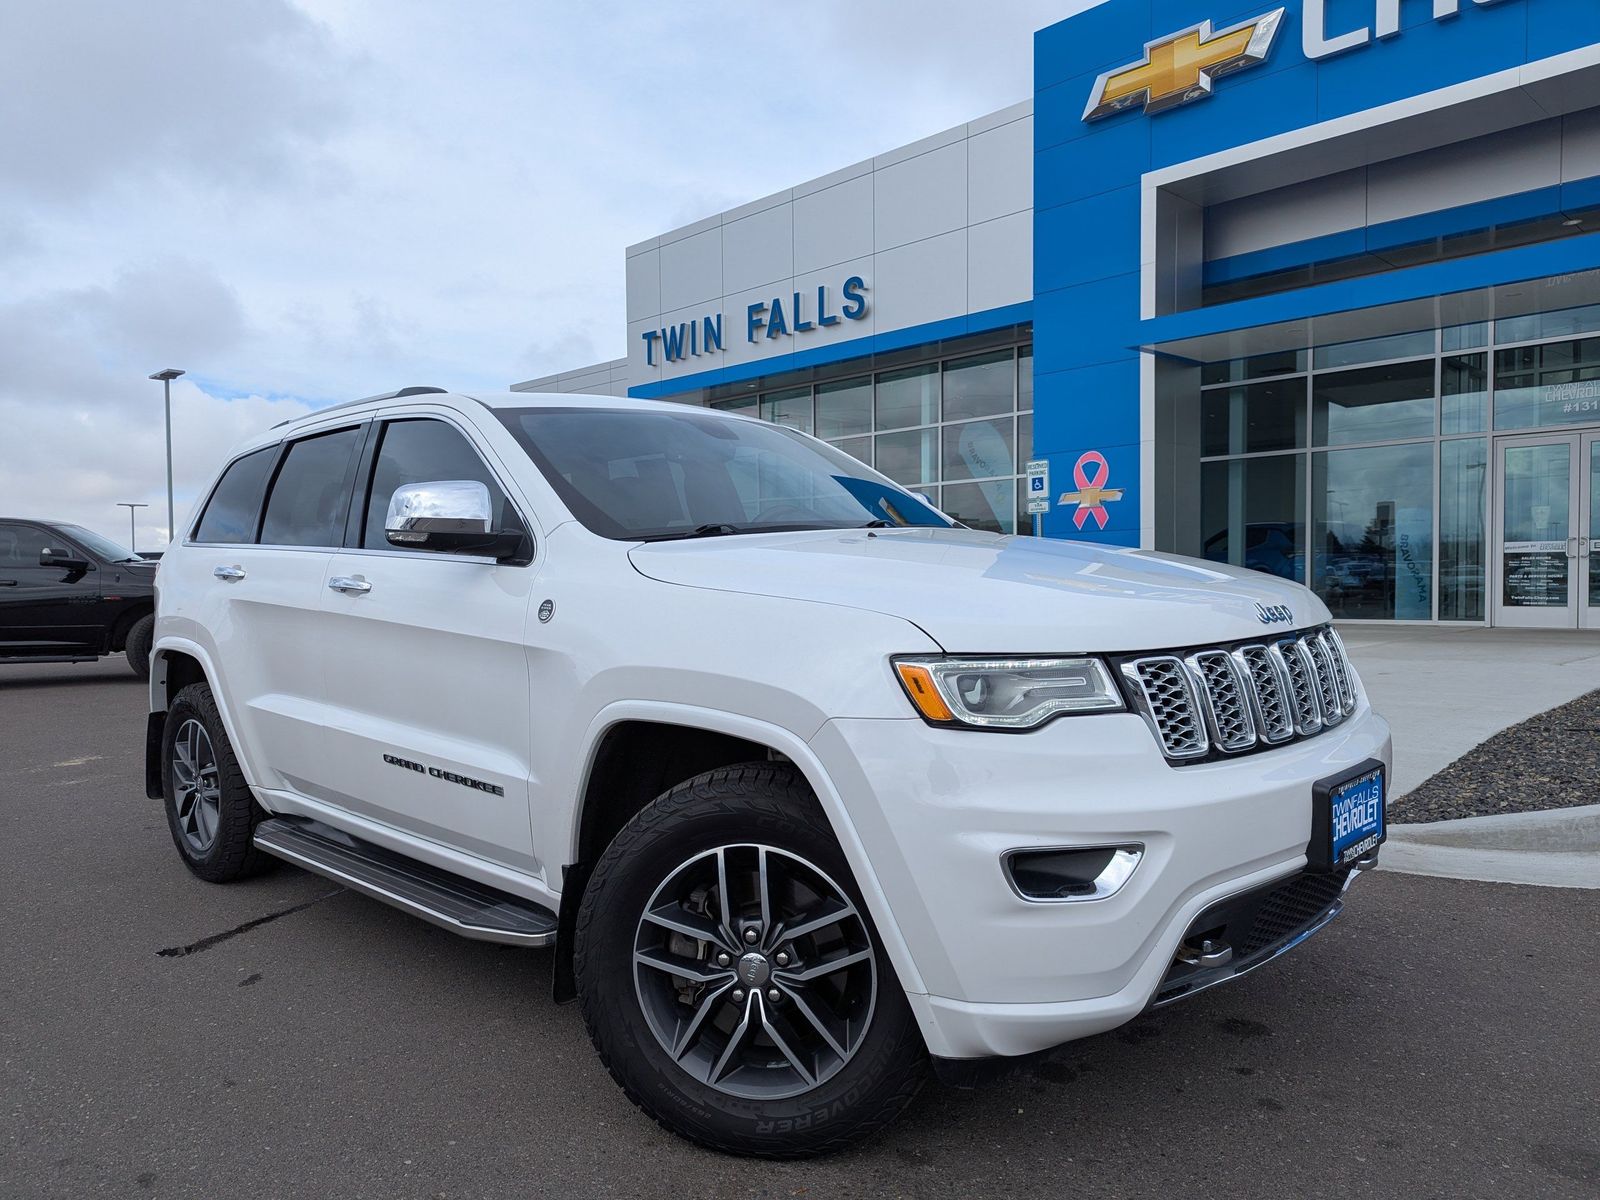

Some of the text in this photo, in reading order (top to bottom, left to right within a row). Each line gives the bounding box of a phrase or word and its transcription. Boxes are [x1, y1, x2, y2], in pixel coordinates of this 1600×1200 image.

[642, 276, 870, 367] TWIN FALLS
[1253, 602, 1293, 625] Jeep
[383, 753, 505, 798] GRAND CHEROKEE
